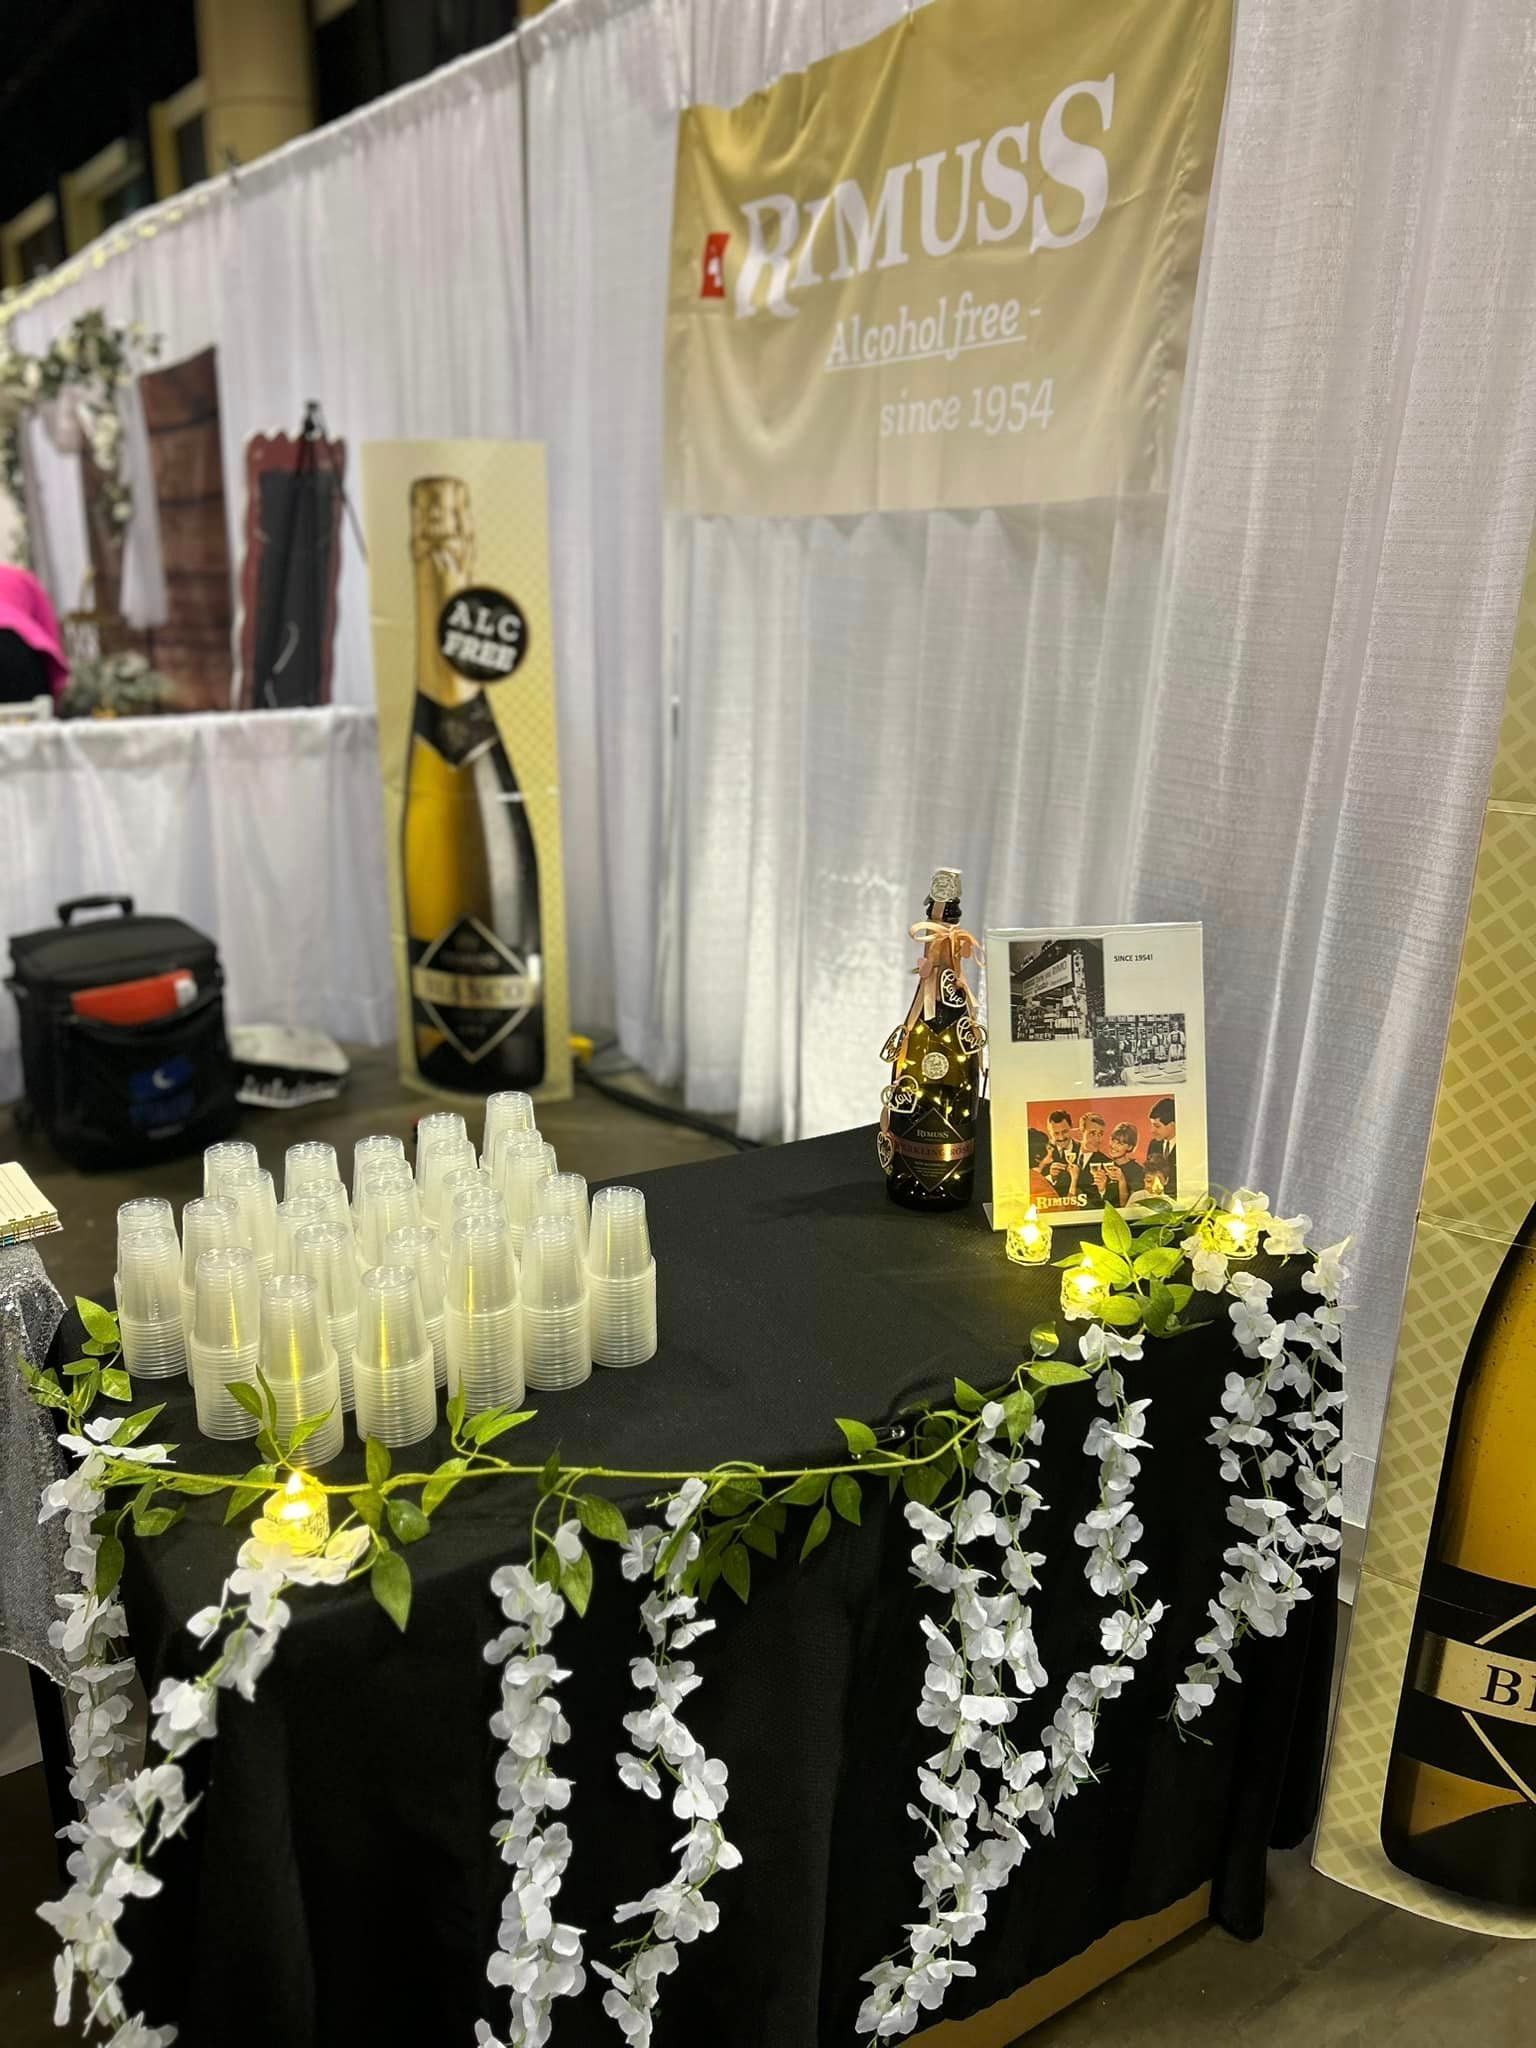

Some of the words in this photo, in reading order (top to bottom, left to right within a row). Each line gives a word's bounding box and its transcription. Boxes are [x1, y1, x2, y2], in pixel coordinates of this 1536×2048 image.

[735, 73, 1115, 319] RIMUSS
[824, 296, 947, 370] Alcohol
[946, 290, 1021, 360] free
[880, 388, 961, 437] since
[968, 377, 1055, 435] 1954
[447, 599, 522, 642] ALC
[443, 629, 518, 673] FREE
[1113, 954, 1133, 962] SINCE
[1134, 953, 1153, 962] 1954!
[1036, 1193, 1088, 1210] RIMUSS
